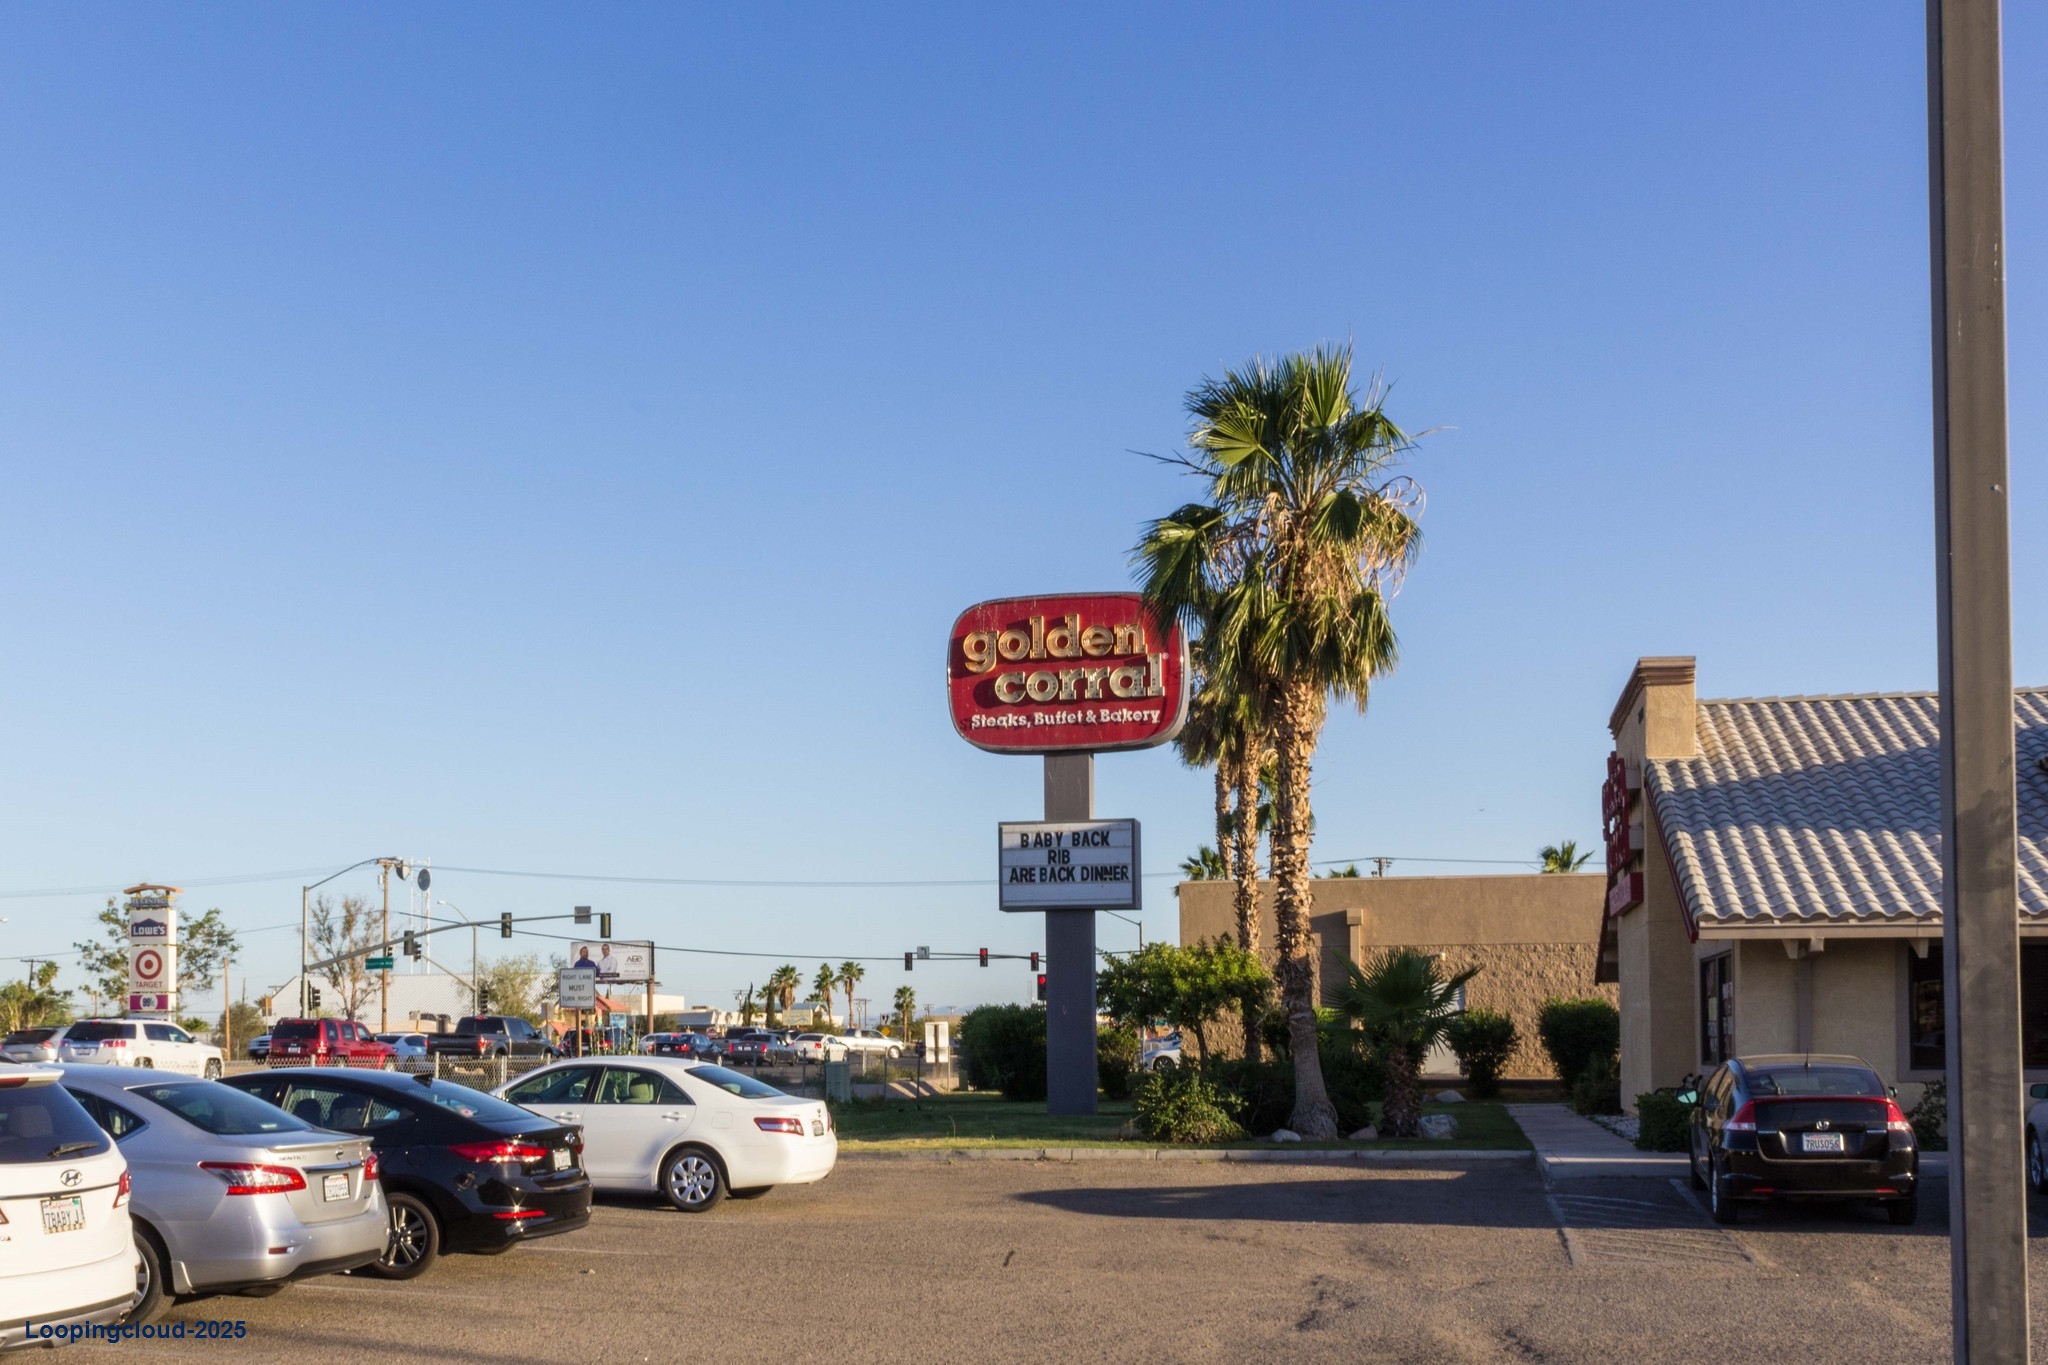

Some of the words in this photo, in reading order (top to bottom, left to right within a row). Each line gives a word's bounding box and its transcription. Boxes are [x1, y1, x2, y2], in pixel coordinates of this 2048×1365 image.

[963, 613, 1148, 674] golden
[994, 652, 1165, 704] corral
[971, 712, 1032, 730] Steaks,
[1035, 709, 1083, 725] Buffet
[1086, 710, 1097, 723] &
[1100, 708, 1161, 725] Bakery
[1020, 832, 1064, 848] BABY
[1072, 831, 1110, 847] BACK
[1047, 849, 1071, 864] RIB
[1009, 867, 1036, 883] ARE
[1039, 866, 1075, 882] BACK
[1080, 865, 1129, 882] DINNER
[133, 926, 166, 936] LOWE'S
[135, 981, 163, 989] TARGET
[568, 984, 585, 992] MUST
